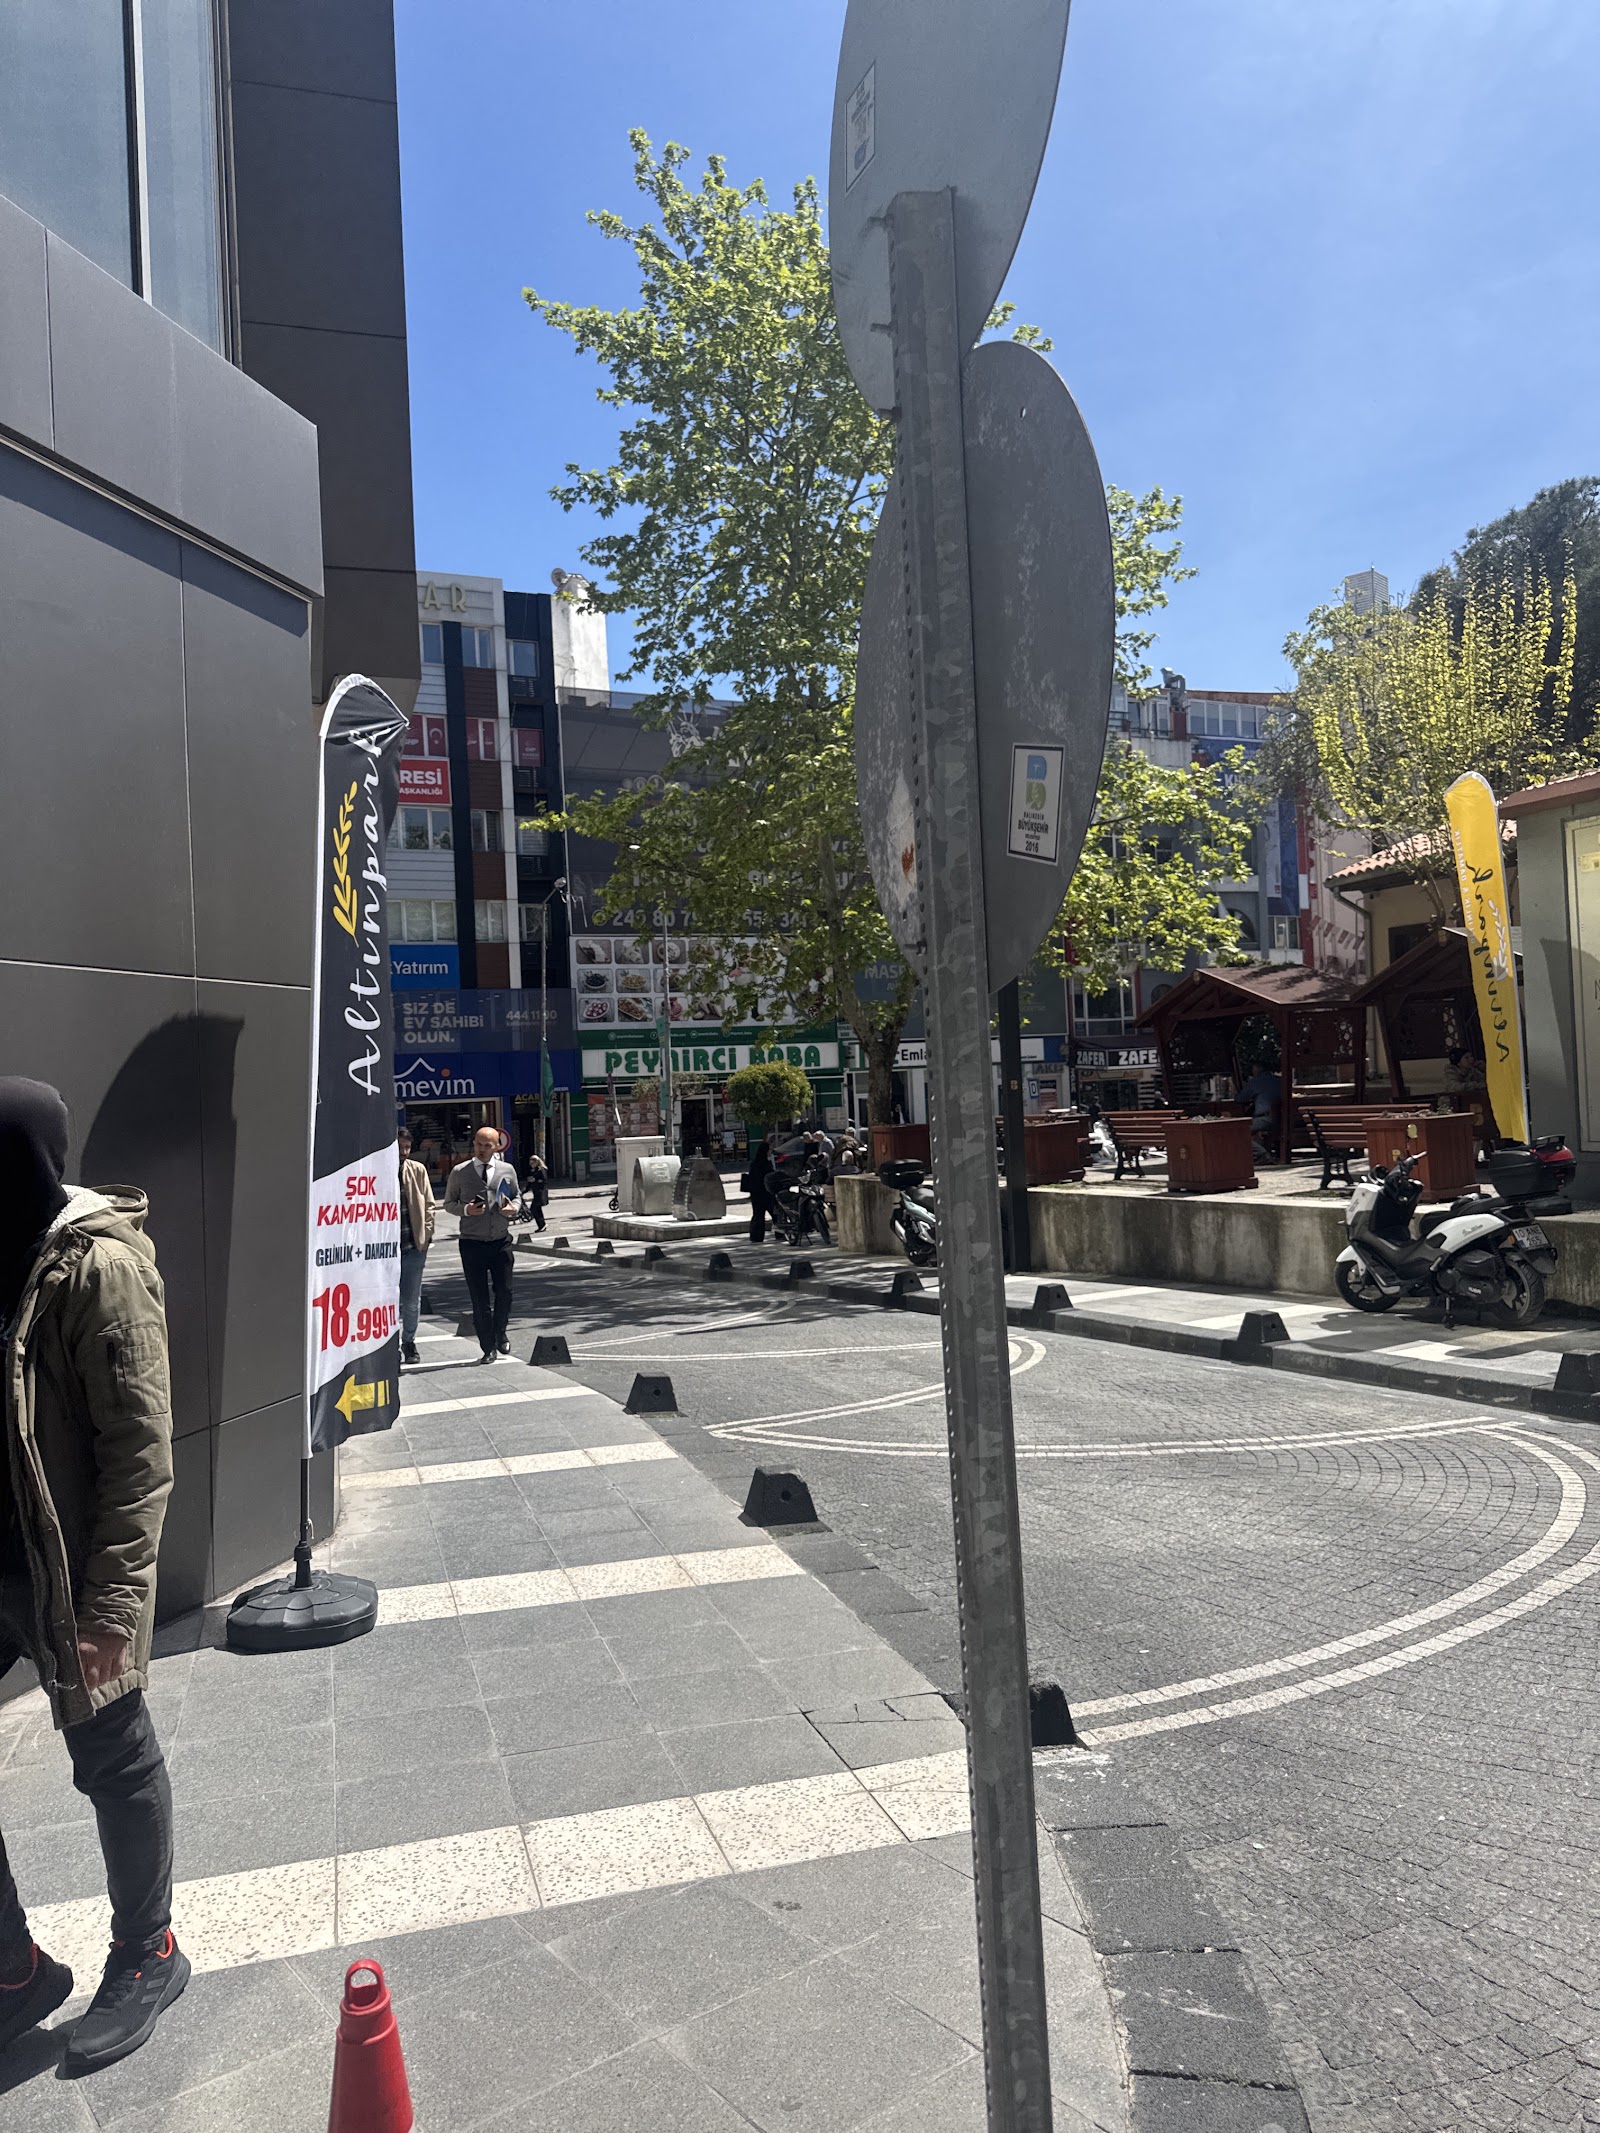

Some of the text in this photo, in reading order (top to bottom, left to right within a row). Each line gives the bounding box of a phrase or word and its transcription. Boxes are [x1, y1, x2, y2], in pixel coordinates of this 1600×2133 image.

[400, 768, 442, 785] RESİ
[402, 1002, 456, 1015] SİZ DE
[506, 1010, 529, 1020] 444
[404, 1015, 484, 1029] EV SAHİBİ
[404, 1031, 455, 1044] OLUN.
[1076, 1051, 1105, 1066] ZAFER
[1118, 1049, 1160, 1066] ZAFE
[515, 1093, 558, 1102] ACARR
[345, 1176, 377, 1200] ŞOK
[317, 1202, 398, 1226] KAMPANYA
[316, 1243, 353, 1267] GELİNLİK
